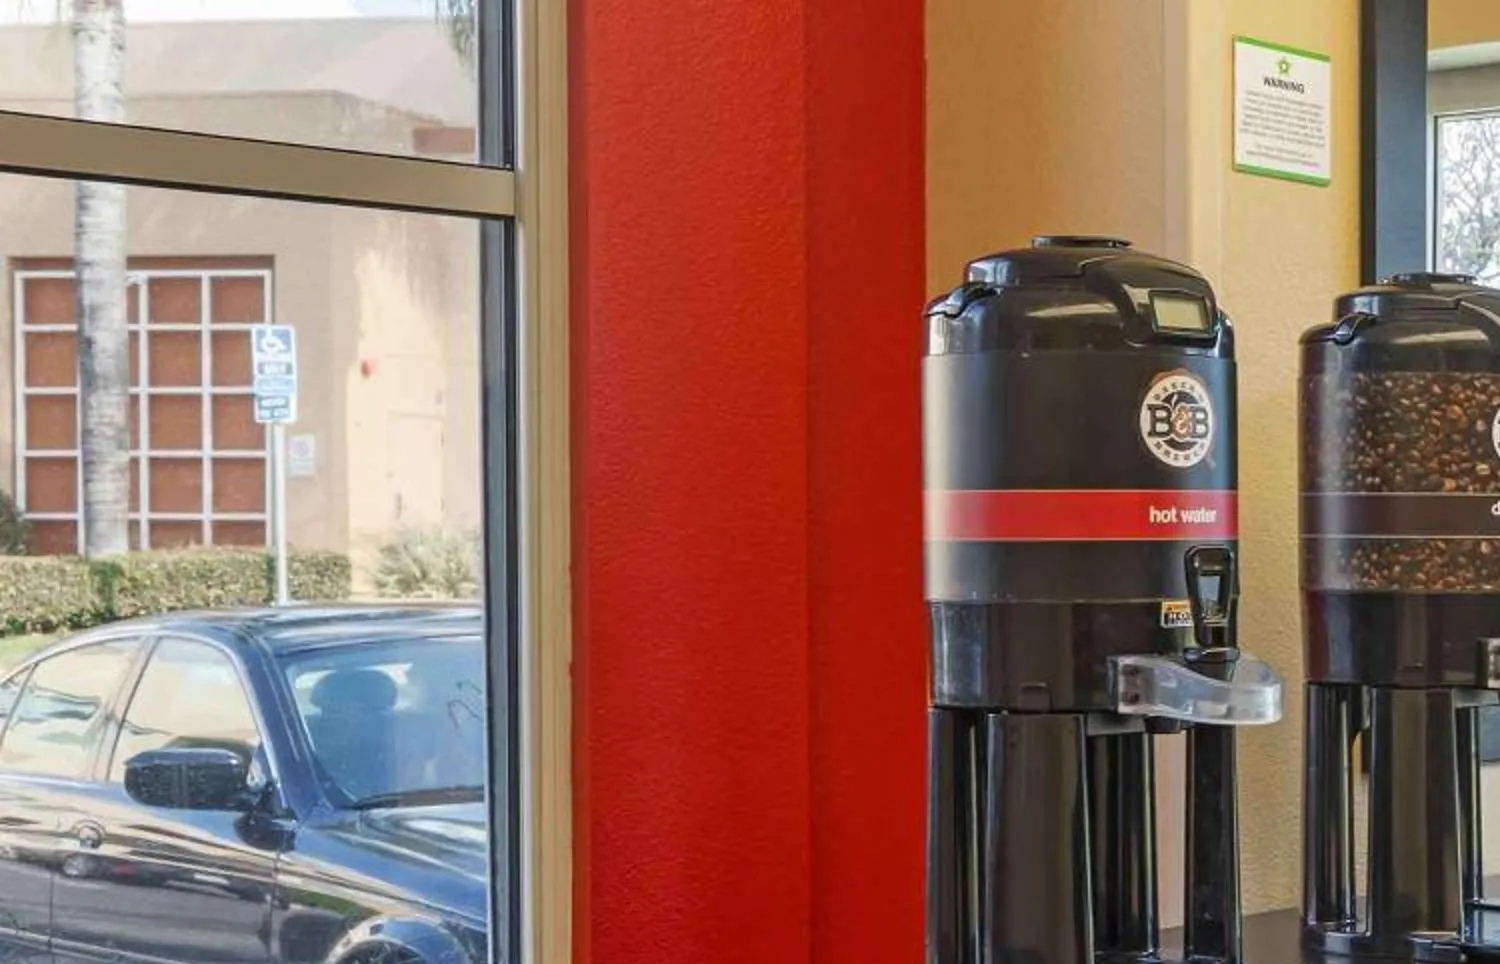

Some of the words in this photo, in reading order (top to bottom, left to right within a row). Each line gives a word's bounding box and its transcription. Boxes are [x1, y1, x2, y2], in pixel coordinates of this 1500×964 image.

[1263, 76, 1305, 94] WARNING
[1147, 402, 1210, 442] B&B
[1149, 505, 1178, 523] hot
[1180, 506, 1217, 523] water
